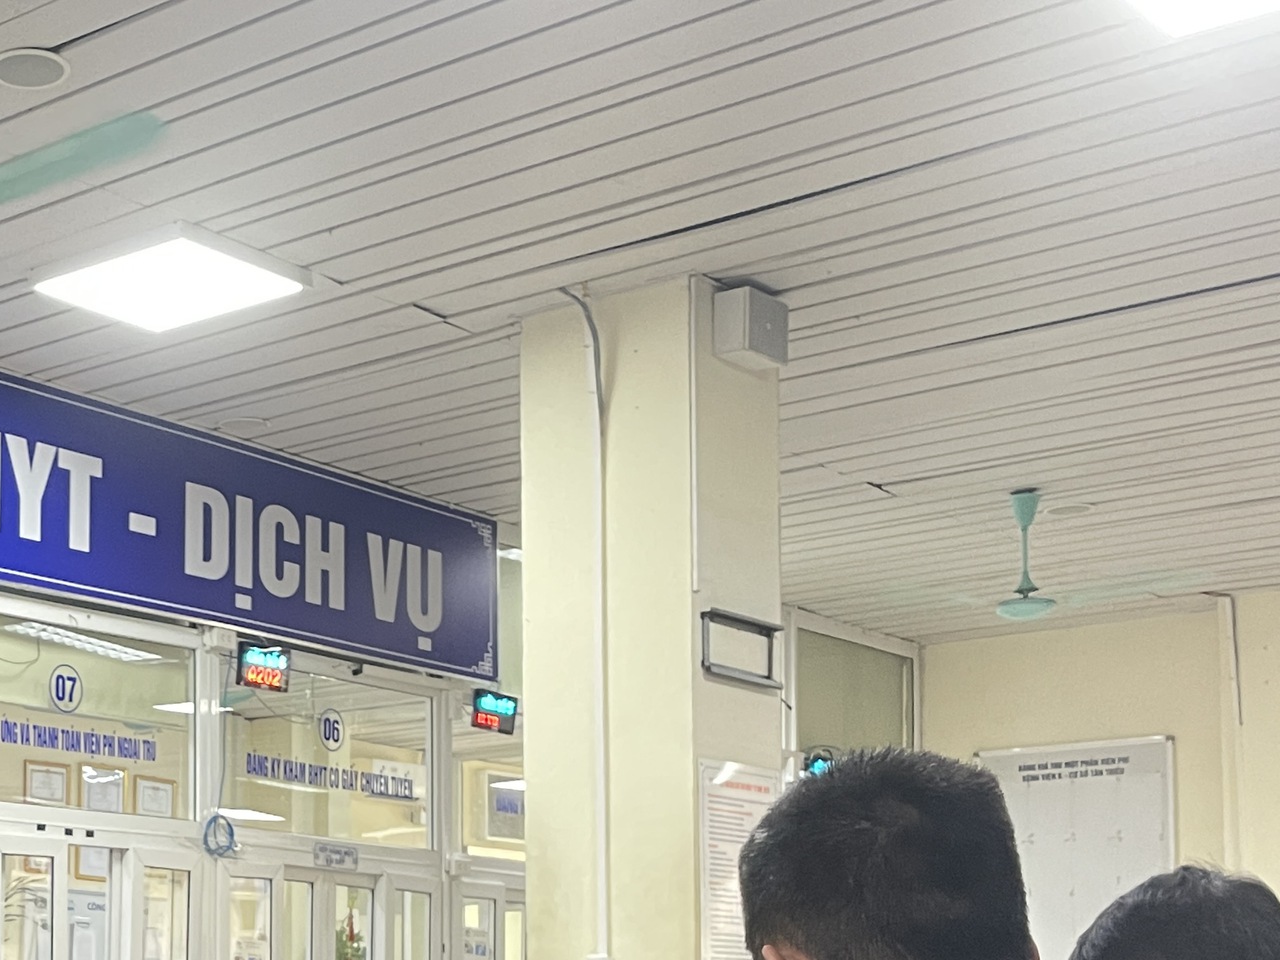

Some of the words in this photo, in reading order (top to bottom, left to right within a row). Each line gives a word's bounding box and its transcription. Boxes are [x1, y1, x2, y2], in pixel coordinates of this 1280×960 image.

[129, 512, 156, 536] -
[184, 481, 344, 611] DỊCH
[367, 532, 442, 651] VỤ
[55, 675, 77, 702] 07
[20, 718, 30, 746] VÀ
[33, 725, 59, 749] THANH
[61, 725, 81, 753] TOÁN
[83, 728, 101, 759] VIỆN
[103, 730, 115, 757] PHÍ
[118, 736, 140, 764] NGOẠI
[142, 734, 156, 762] TRÚ
[324, 718, 340, 743] 06
[283, 756, 306, 784] KHÁM
[309, 764, 327, 787] BHYT
